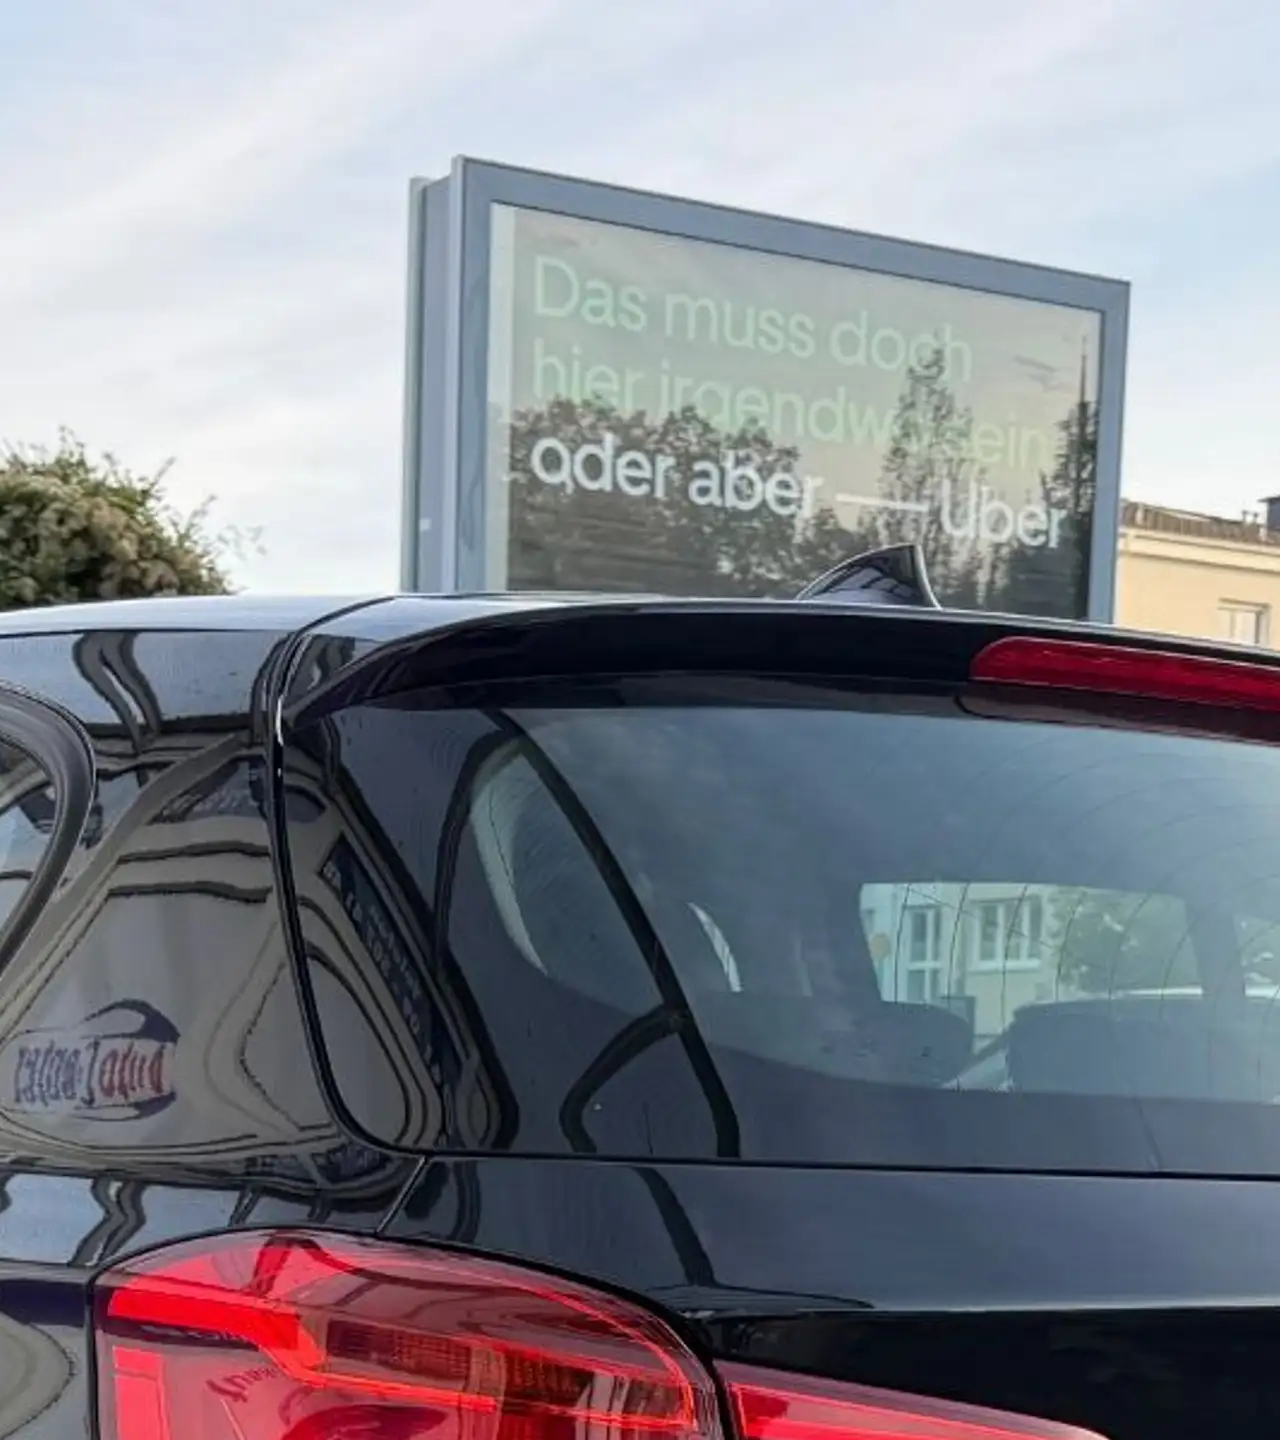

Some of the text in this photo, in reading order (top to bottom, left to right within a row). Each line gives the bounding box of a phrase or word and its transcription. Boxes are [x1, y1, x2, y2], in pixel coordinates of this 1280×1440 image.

[532, 337, 645, 413] hier
[534, 254, 971, 383] Das muss doch
[531, 431, 676, 498] oder
[687, 448, 825, 517] aber
[939, 477, 1068, 549] Uber
